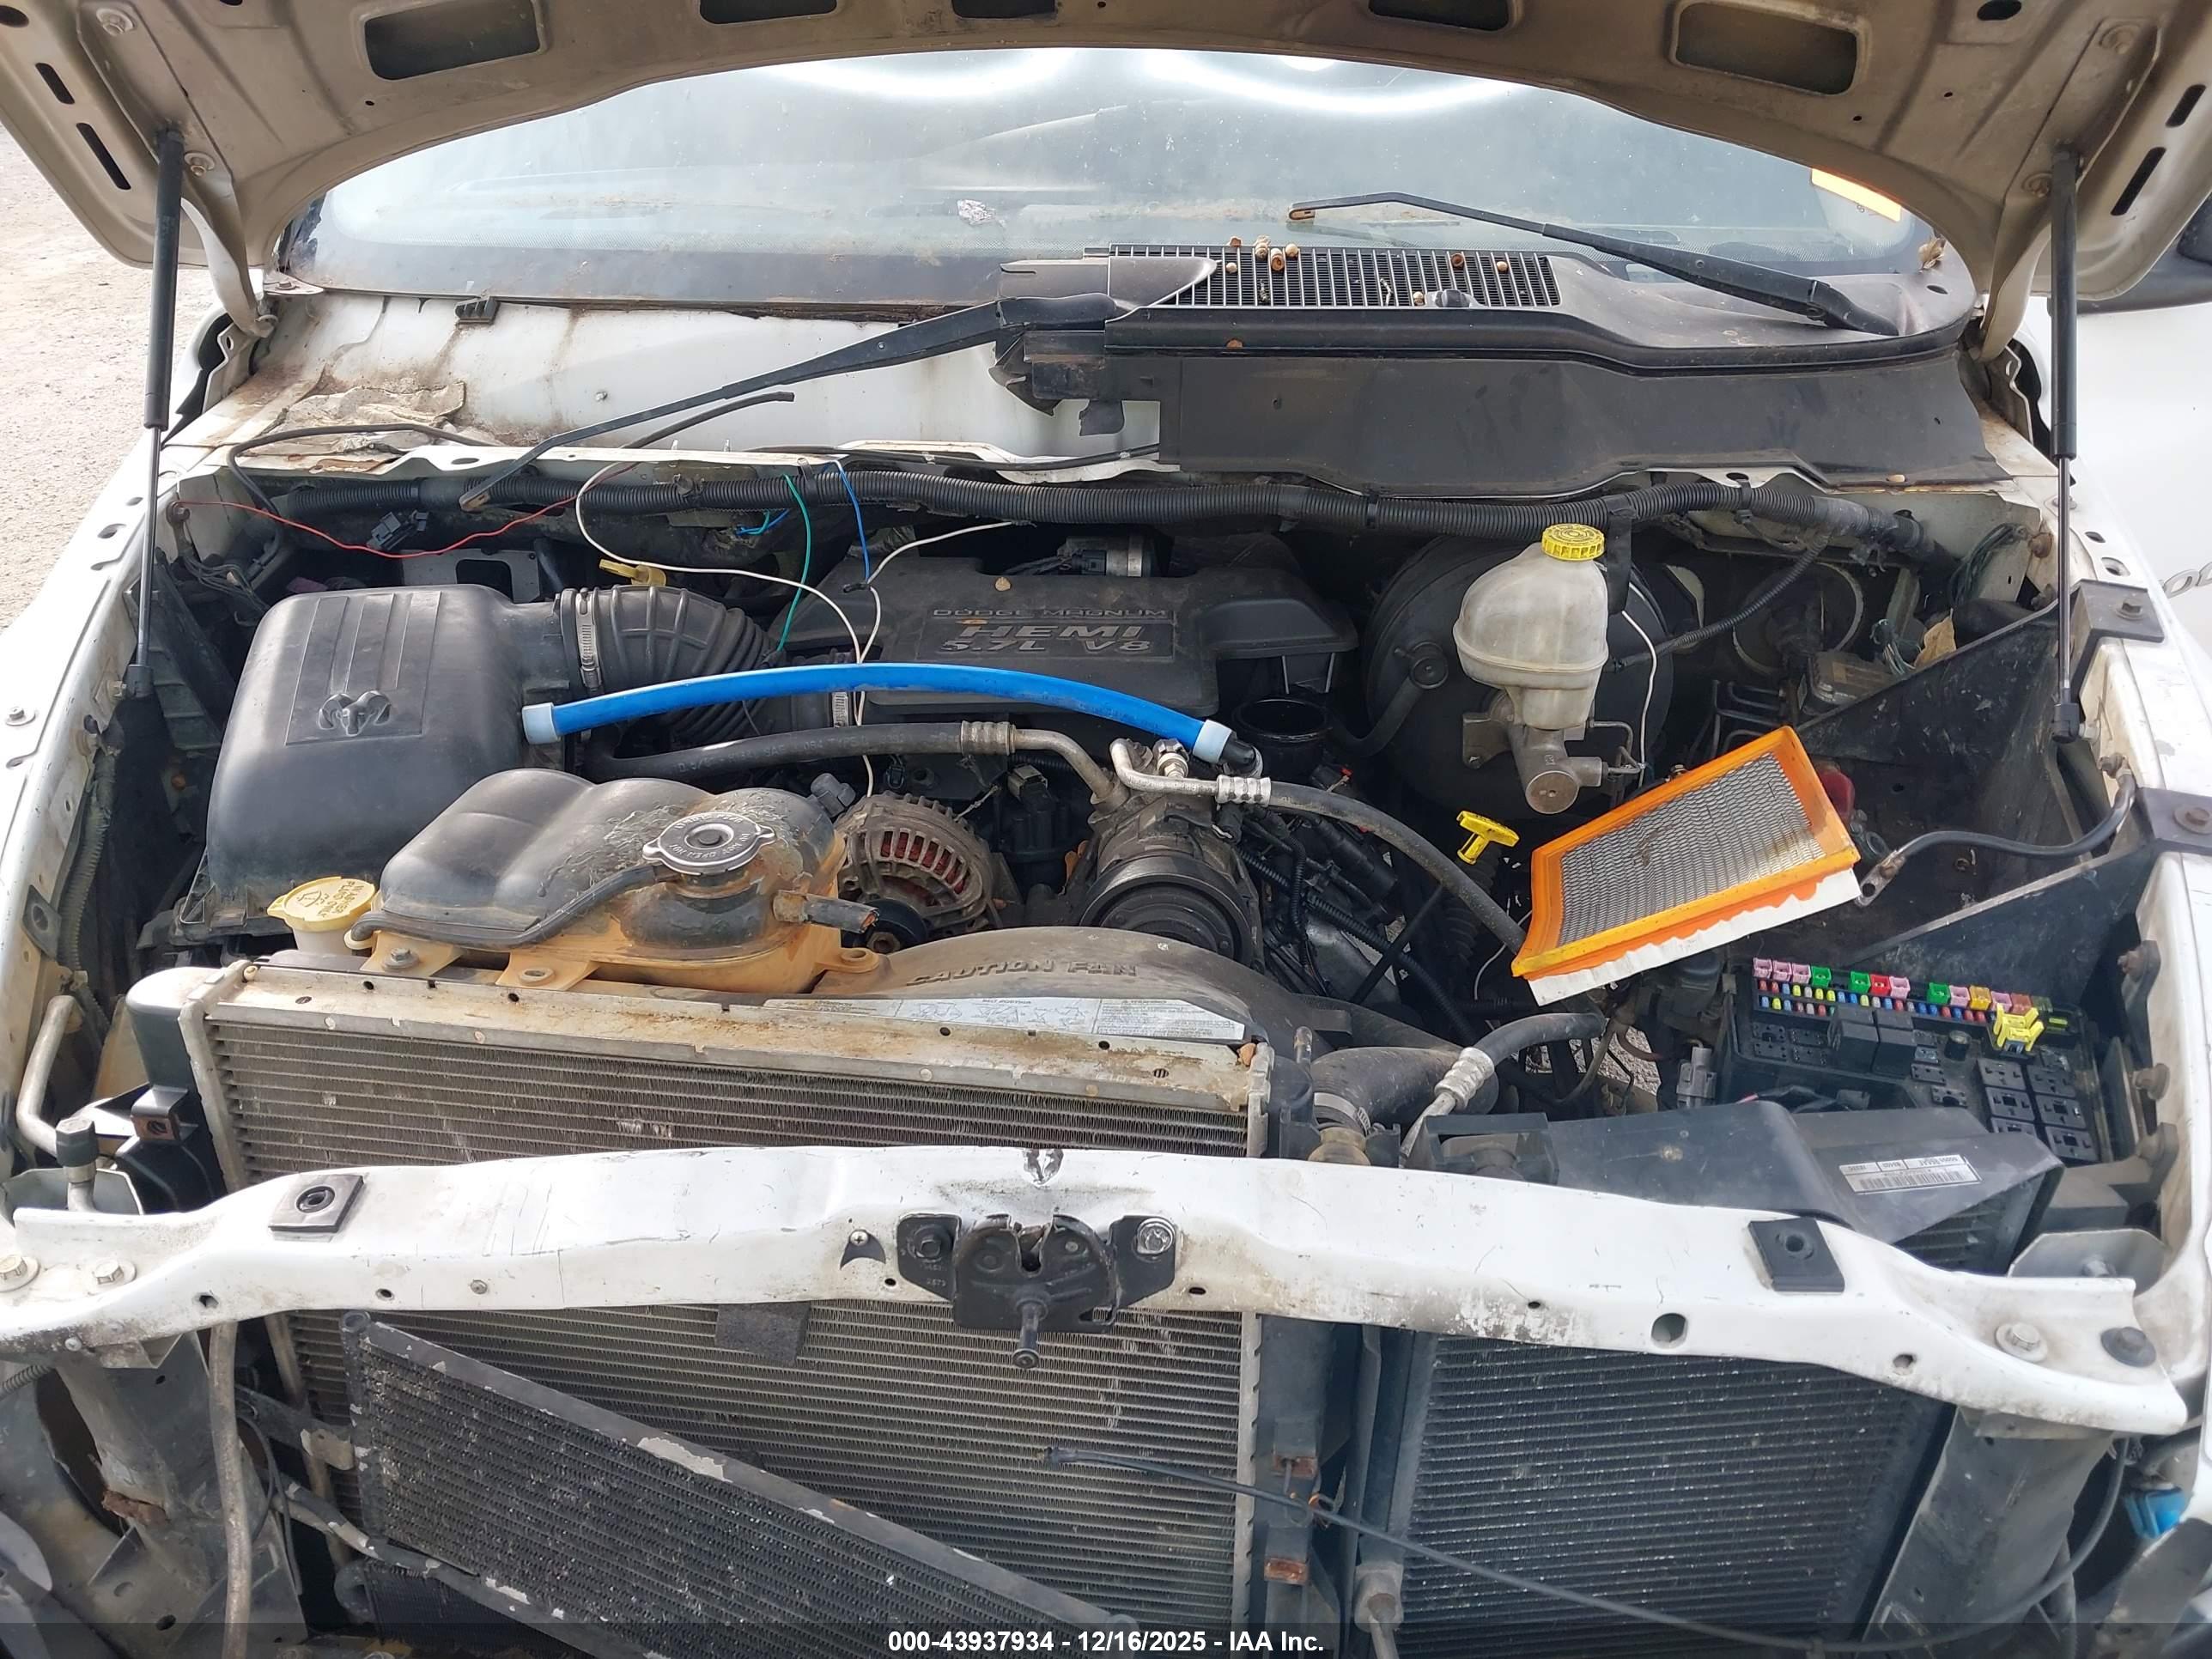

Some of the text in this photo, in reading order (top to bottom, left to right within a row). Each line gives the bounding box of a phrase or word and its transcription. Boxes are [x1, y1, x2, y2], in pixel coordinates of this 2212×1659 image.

[933, 607, 1167, 617] DODGE MAGNUM
[958, 624, 1144, 639] HEMI
[940, 638, 1152, 653] 5.7L V8
[905, 958, 1139, 987] CAUTION FAN
